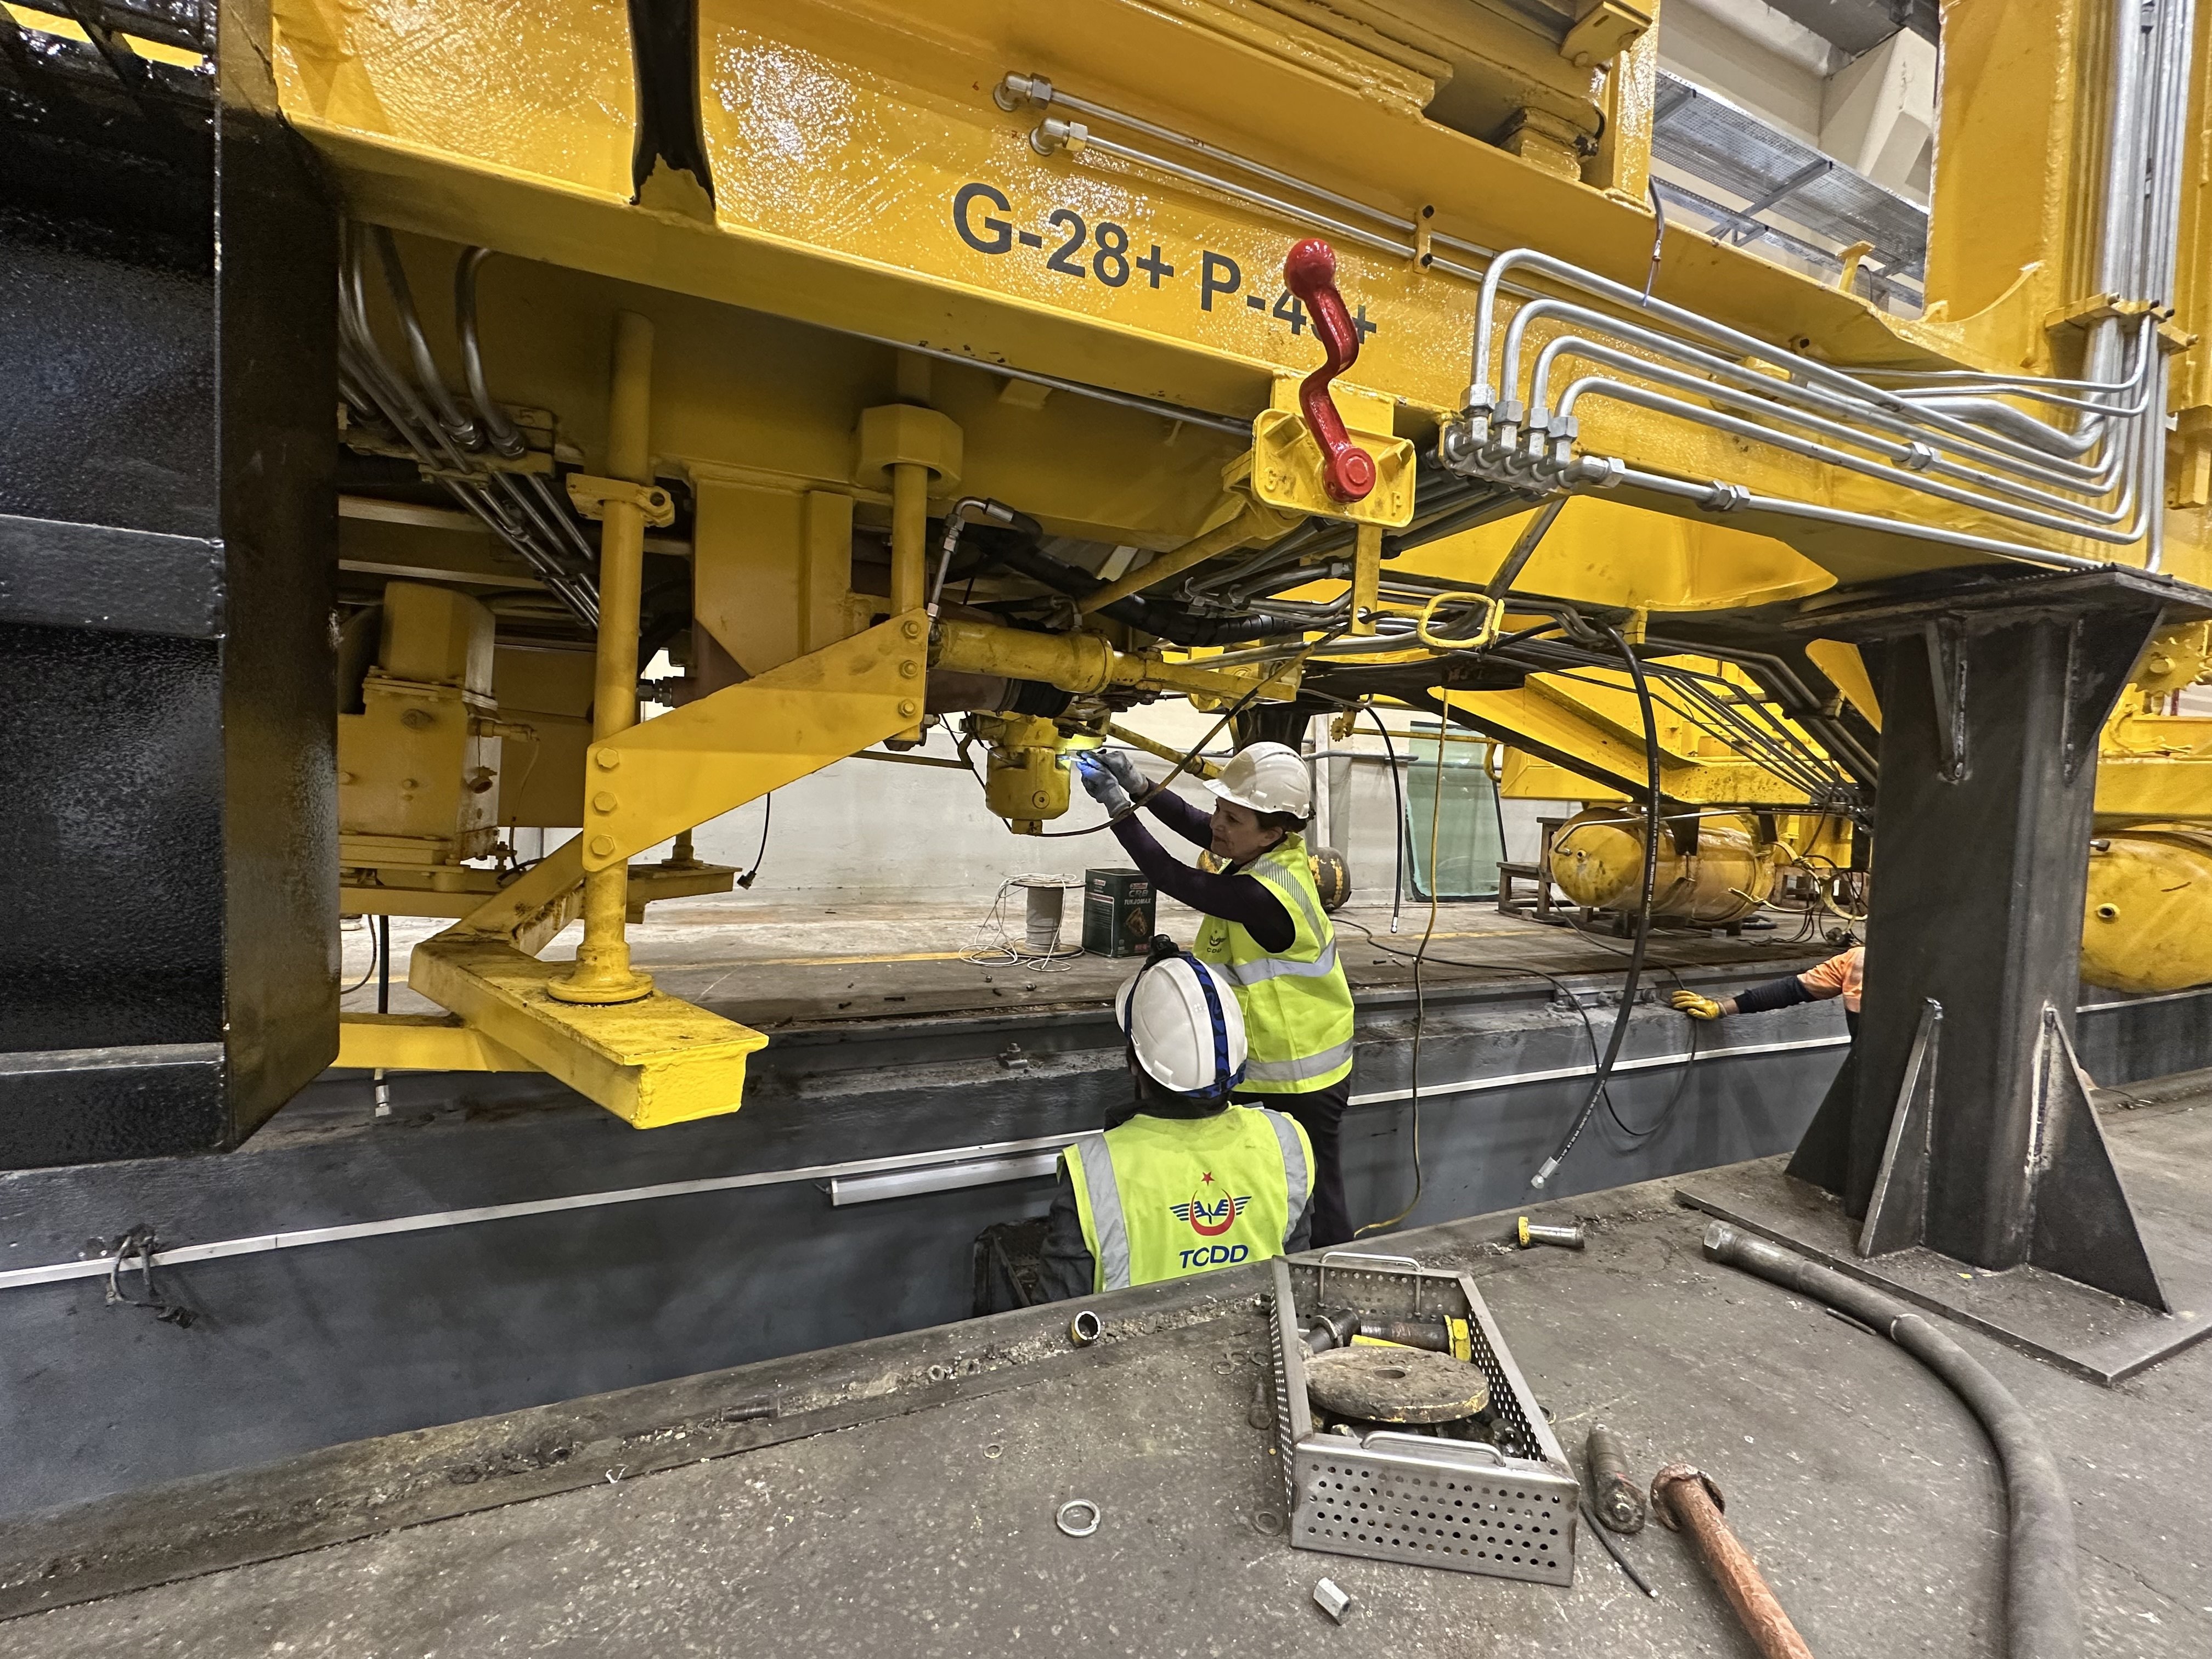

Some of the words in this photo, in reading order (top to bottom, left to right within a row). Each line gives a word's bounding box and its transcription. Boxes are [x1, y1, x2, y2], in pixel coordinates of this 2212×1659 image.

[952, 182, 1175, 290] G-28+
[1200, 250, 1378, 345] P-4+
[1180, 1244, 1249, 1269] TCDD
